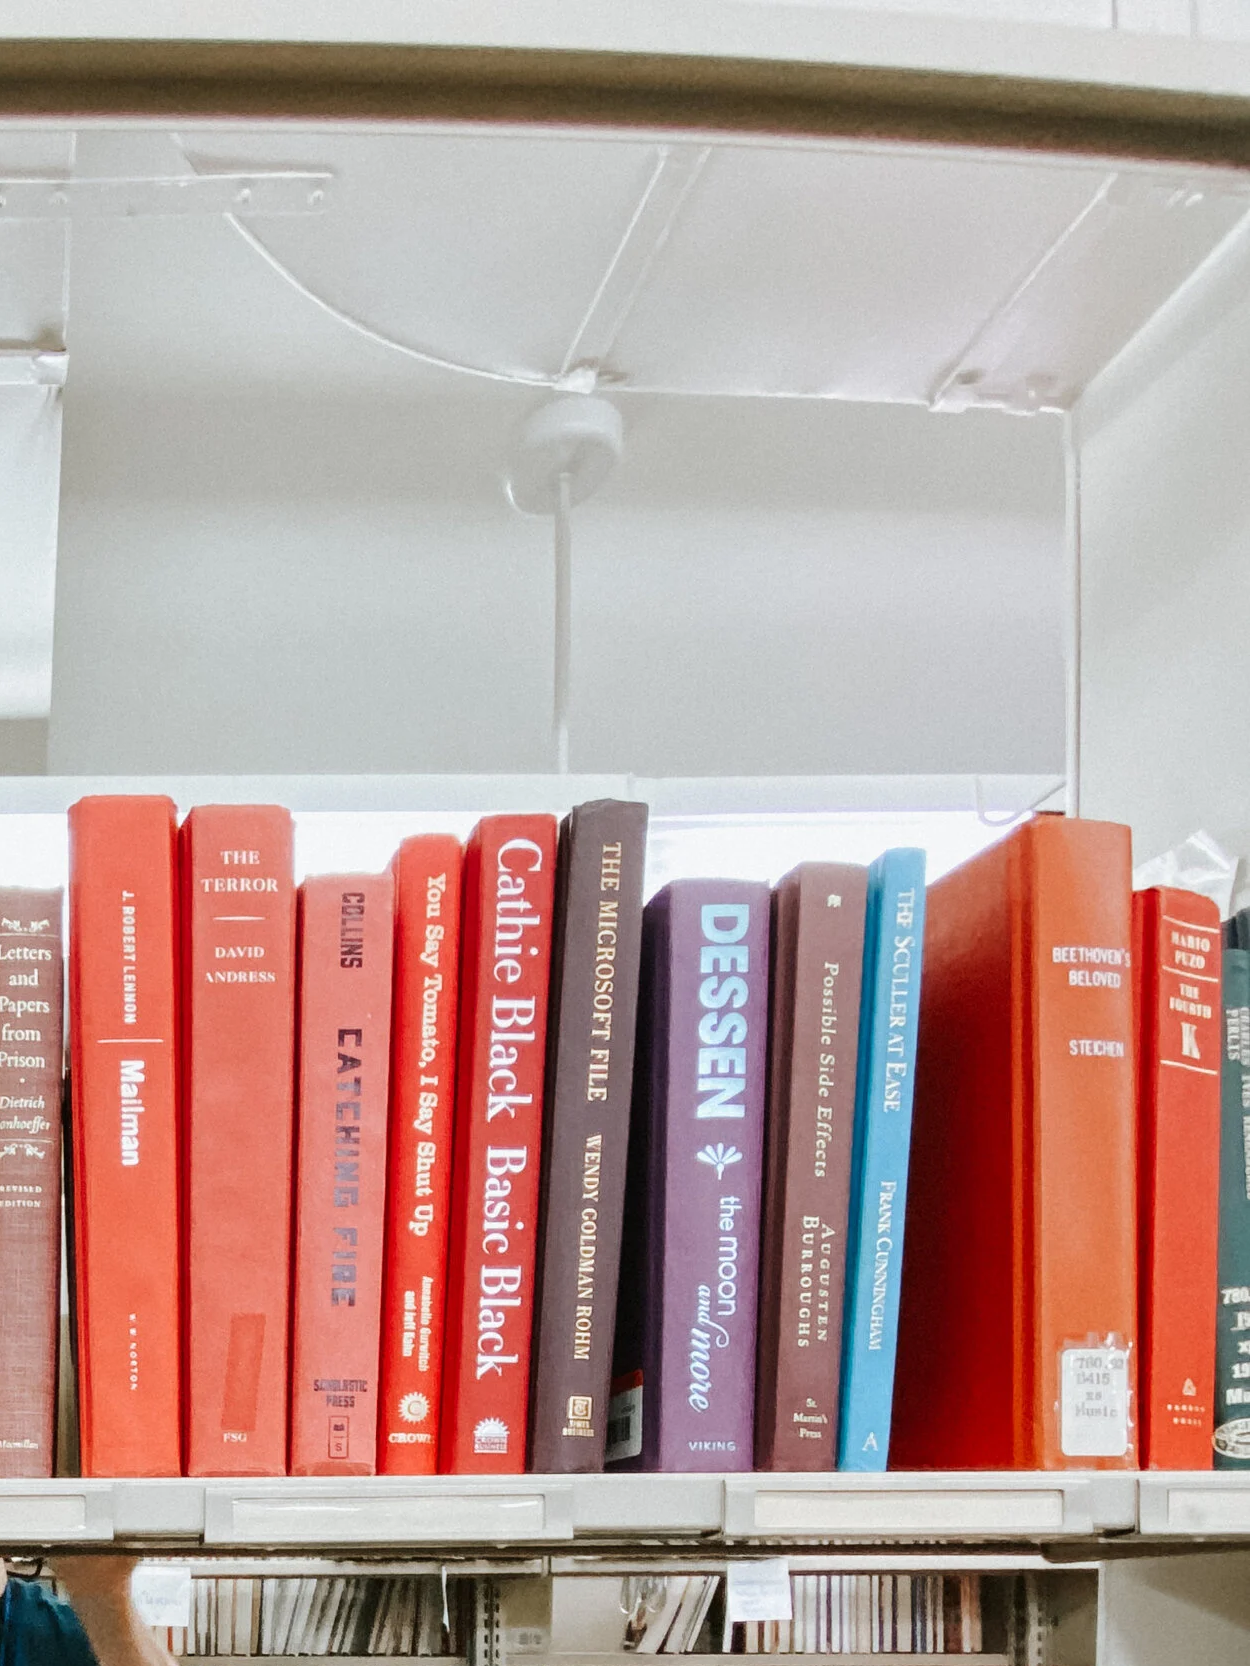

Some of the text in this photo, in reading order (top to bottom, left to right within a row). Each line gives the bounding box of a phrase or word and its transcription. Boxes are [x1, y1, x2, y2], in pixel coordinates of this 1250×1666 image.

[200, 878, 278, 892] TERROR
[220, 850, 259, 865] THE
[8, 969, 39, 986] and
[215, 946, 265, 958] DAVID
[487, 838, 543, 1122] Cathie Black
[587, 842, 622, 1102] THE MICROSOFT FILE
[1068, 970, 1121, 988] BELOVED
[123, 966, 137, 1024] LENNON
[696, 903, 750, 1119] DESSEN
[1, 1023, 41, 1042] from
[407, 873, 446, 1237] You Say I Say Shut Up
[814, 962, 839, 1177] Possible Side Effects
[0, 1096, 45, 1110] Dietrich
[120, 1060, 145, 1166] Mailman
[475, 1145, 527, 1380] Basic Black
[573, 1133, 602, 1360] WENDY GOLDMAN ROHM
[718, 1196, 742, 1316] the moon
[223, 1432, 247, 1443] FSG
[688, 1441, 735, 1451] VIKING
